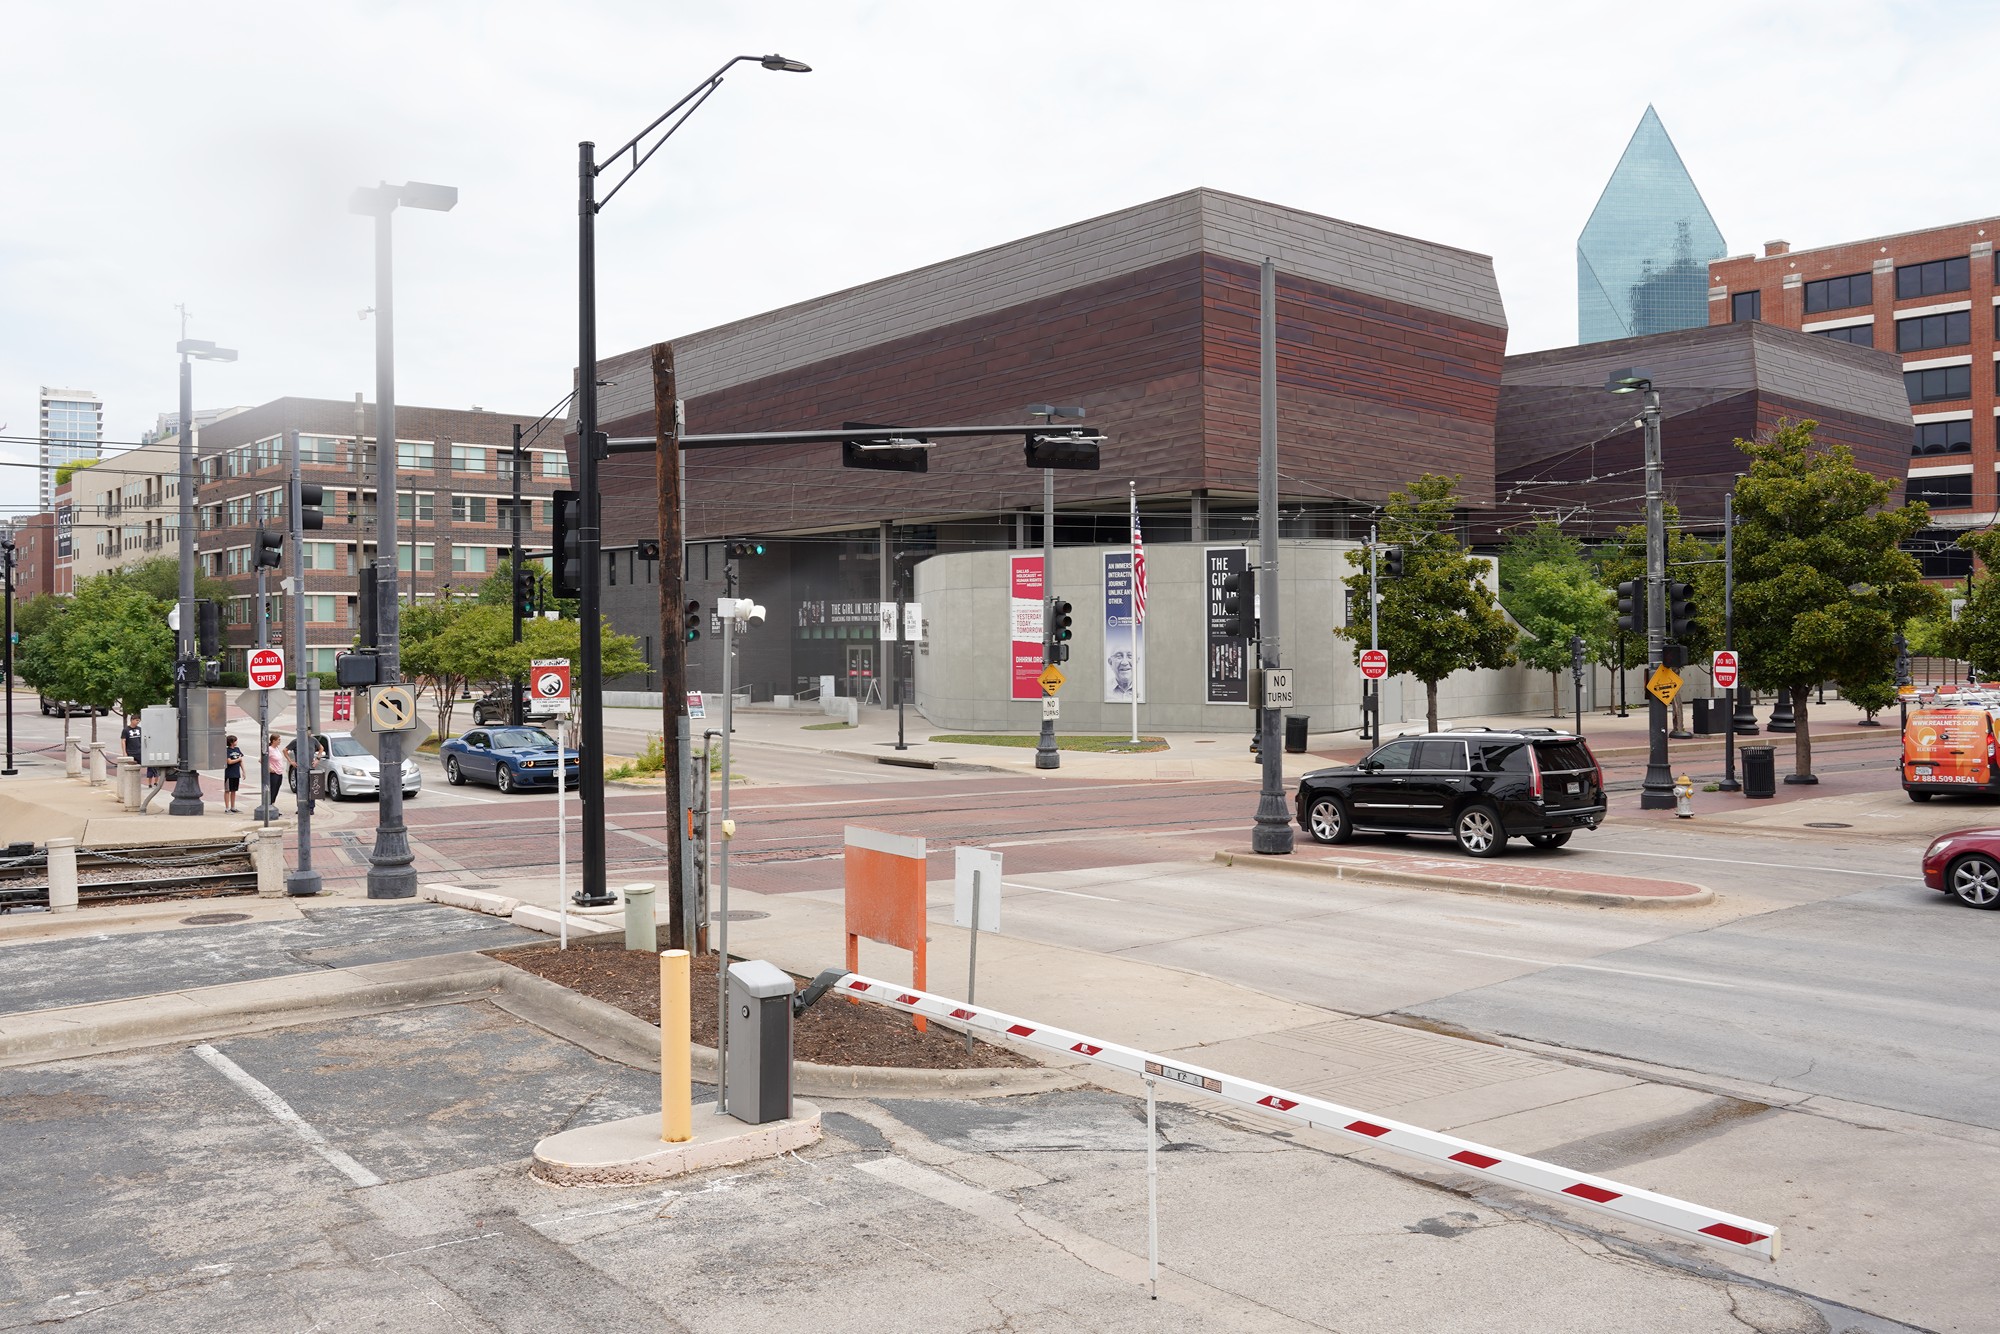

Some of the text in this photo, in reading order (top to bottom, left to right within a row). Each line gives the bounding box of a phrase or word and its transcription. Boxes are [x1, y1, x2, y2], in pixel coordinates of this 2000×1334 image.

[1211, 558, 1228, 570] THE
[1212, 573, 1230, 585] GIR
[1212, 588, 1222, 600] IN
[831, 603, 840, 615] THE
[842, 603, 854, 614] GIRL
[862, 602, 872, 614] THE
[1212, 603, 1237, 615] DIA
[1274, 675, 1286, 686] NO
[1267, 692, 1292, 702] TURNS
